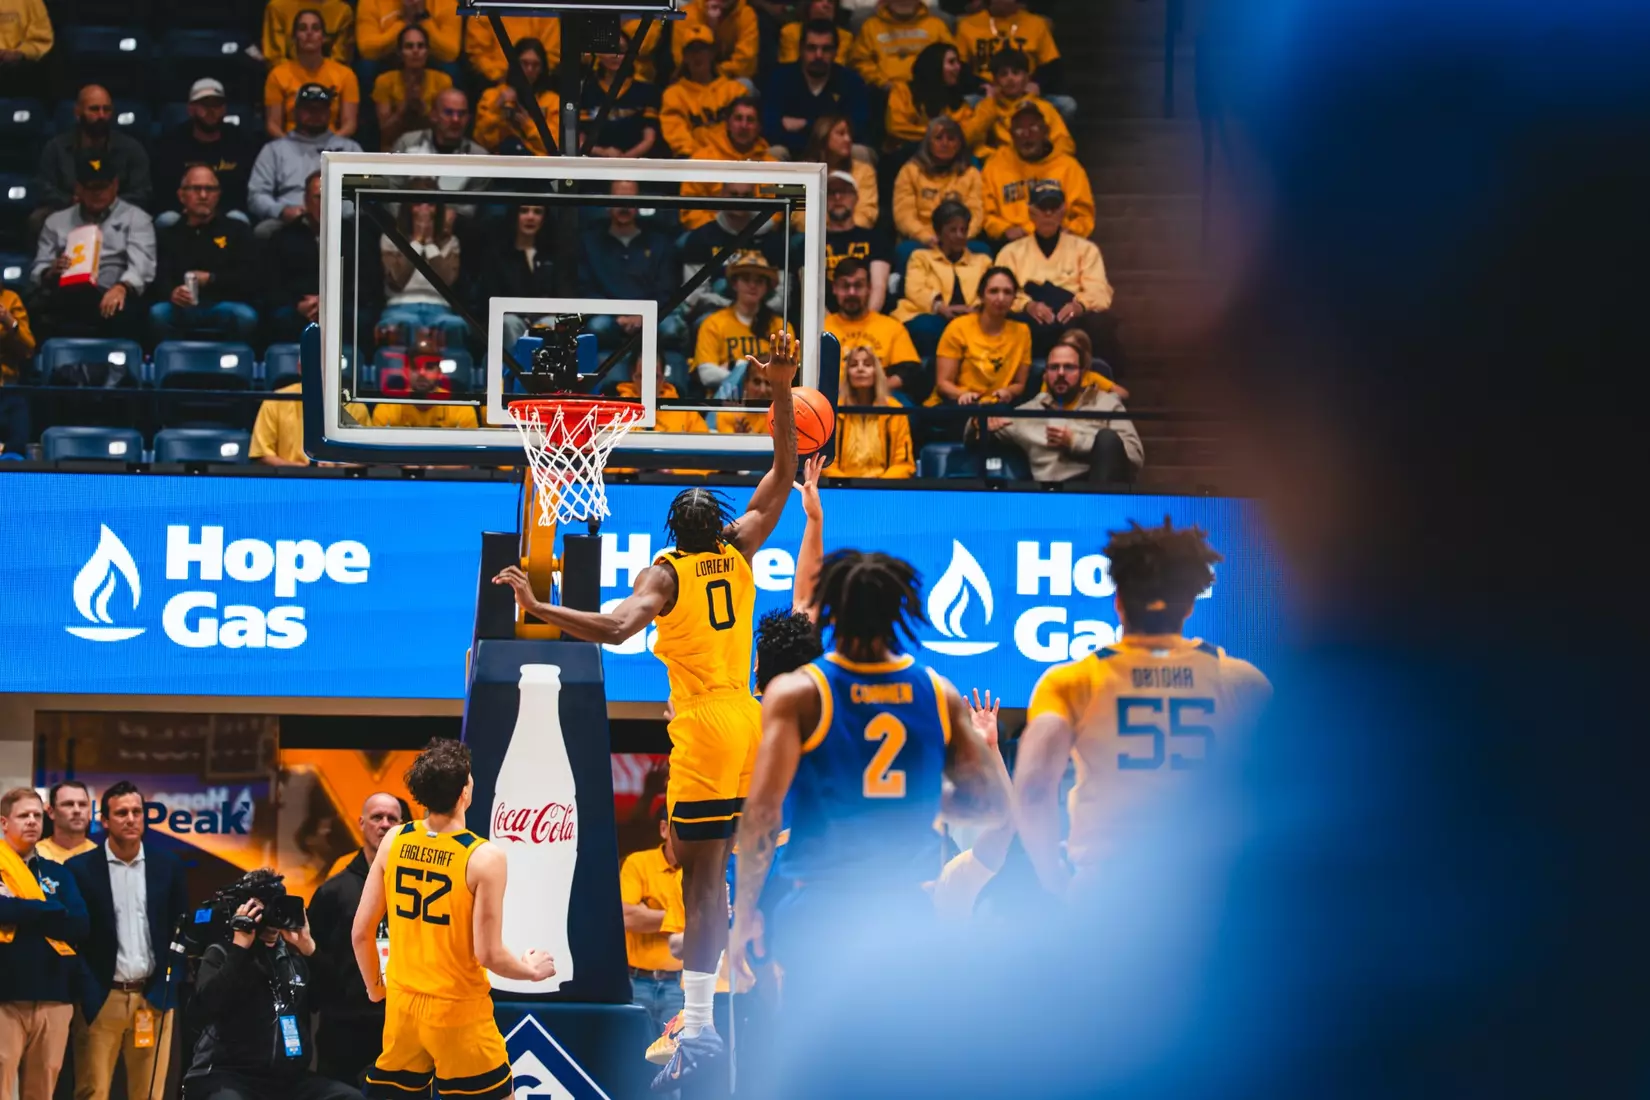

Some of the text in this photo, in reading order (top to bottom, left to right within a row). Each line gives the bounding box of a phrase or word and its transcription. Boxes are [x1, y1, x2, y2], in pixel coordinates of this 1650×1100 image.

[165, 524, 371, 598] Hope
[600, 533, 795, 591] He
[695, 556, 736, 578] LORIENT
[162, 590, 308, 650] Gas
[705, 578, 737, 632] 0
[1013, 605, 1124, 663] Ga
[862, 711, 907, 798] 2
[1116, 697, 1217, 771] 55
[144, 800, 251, 835] Peak
[493, 801, 576, 844] Coca-Cola
[399, 843, 456, 868] EAGLESTAFF
[395, 865, 453, 926] 52
